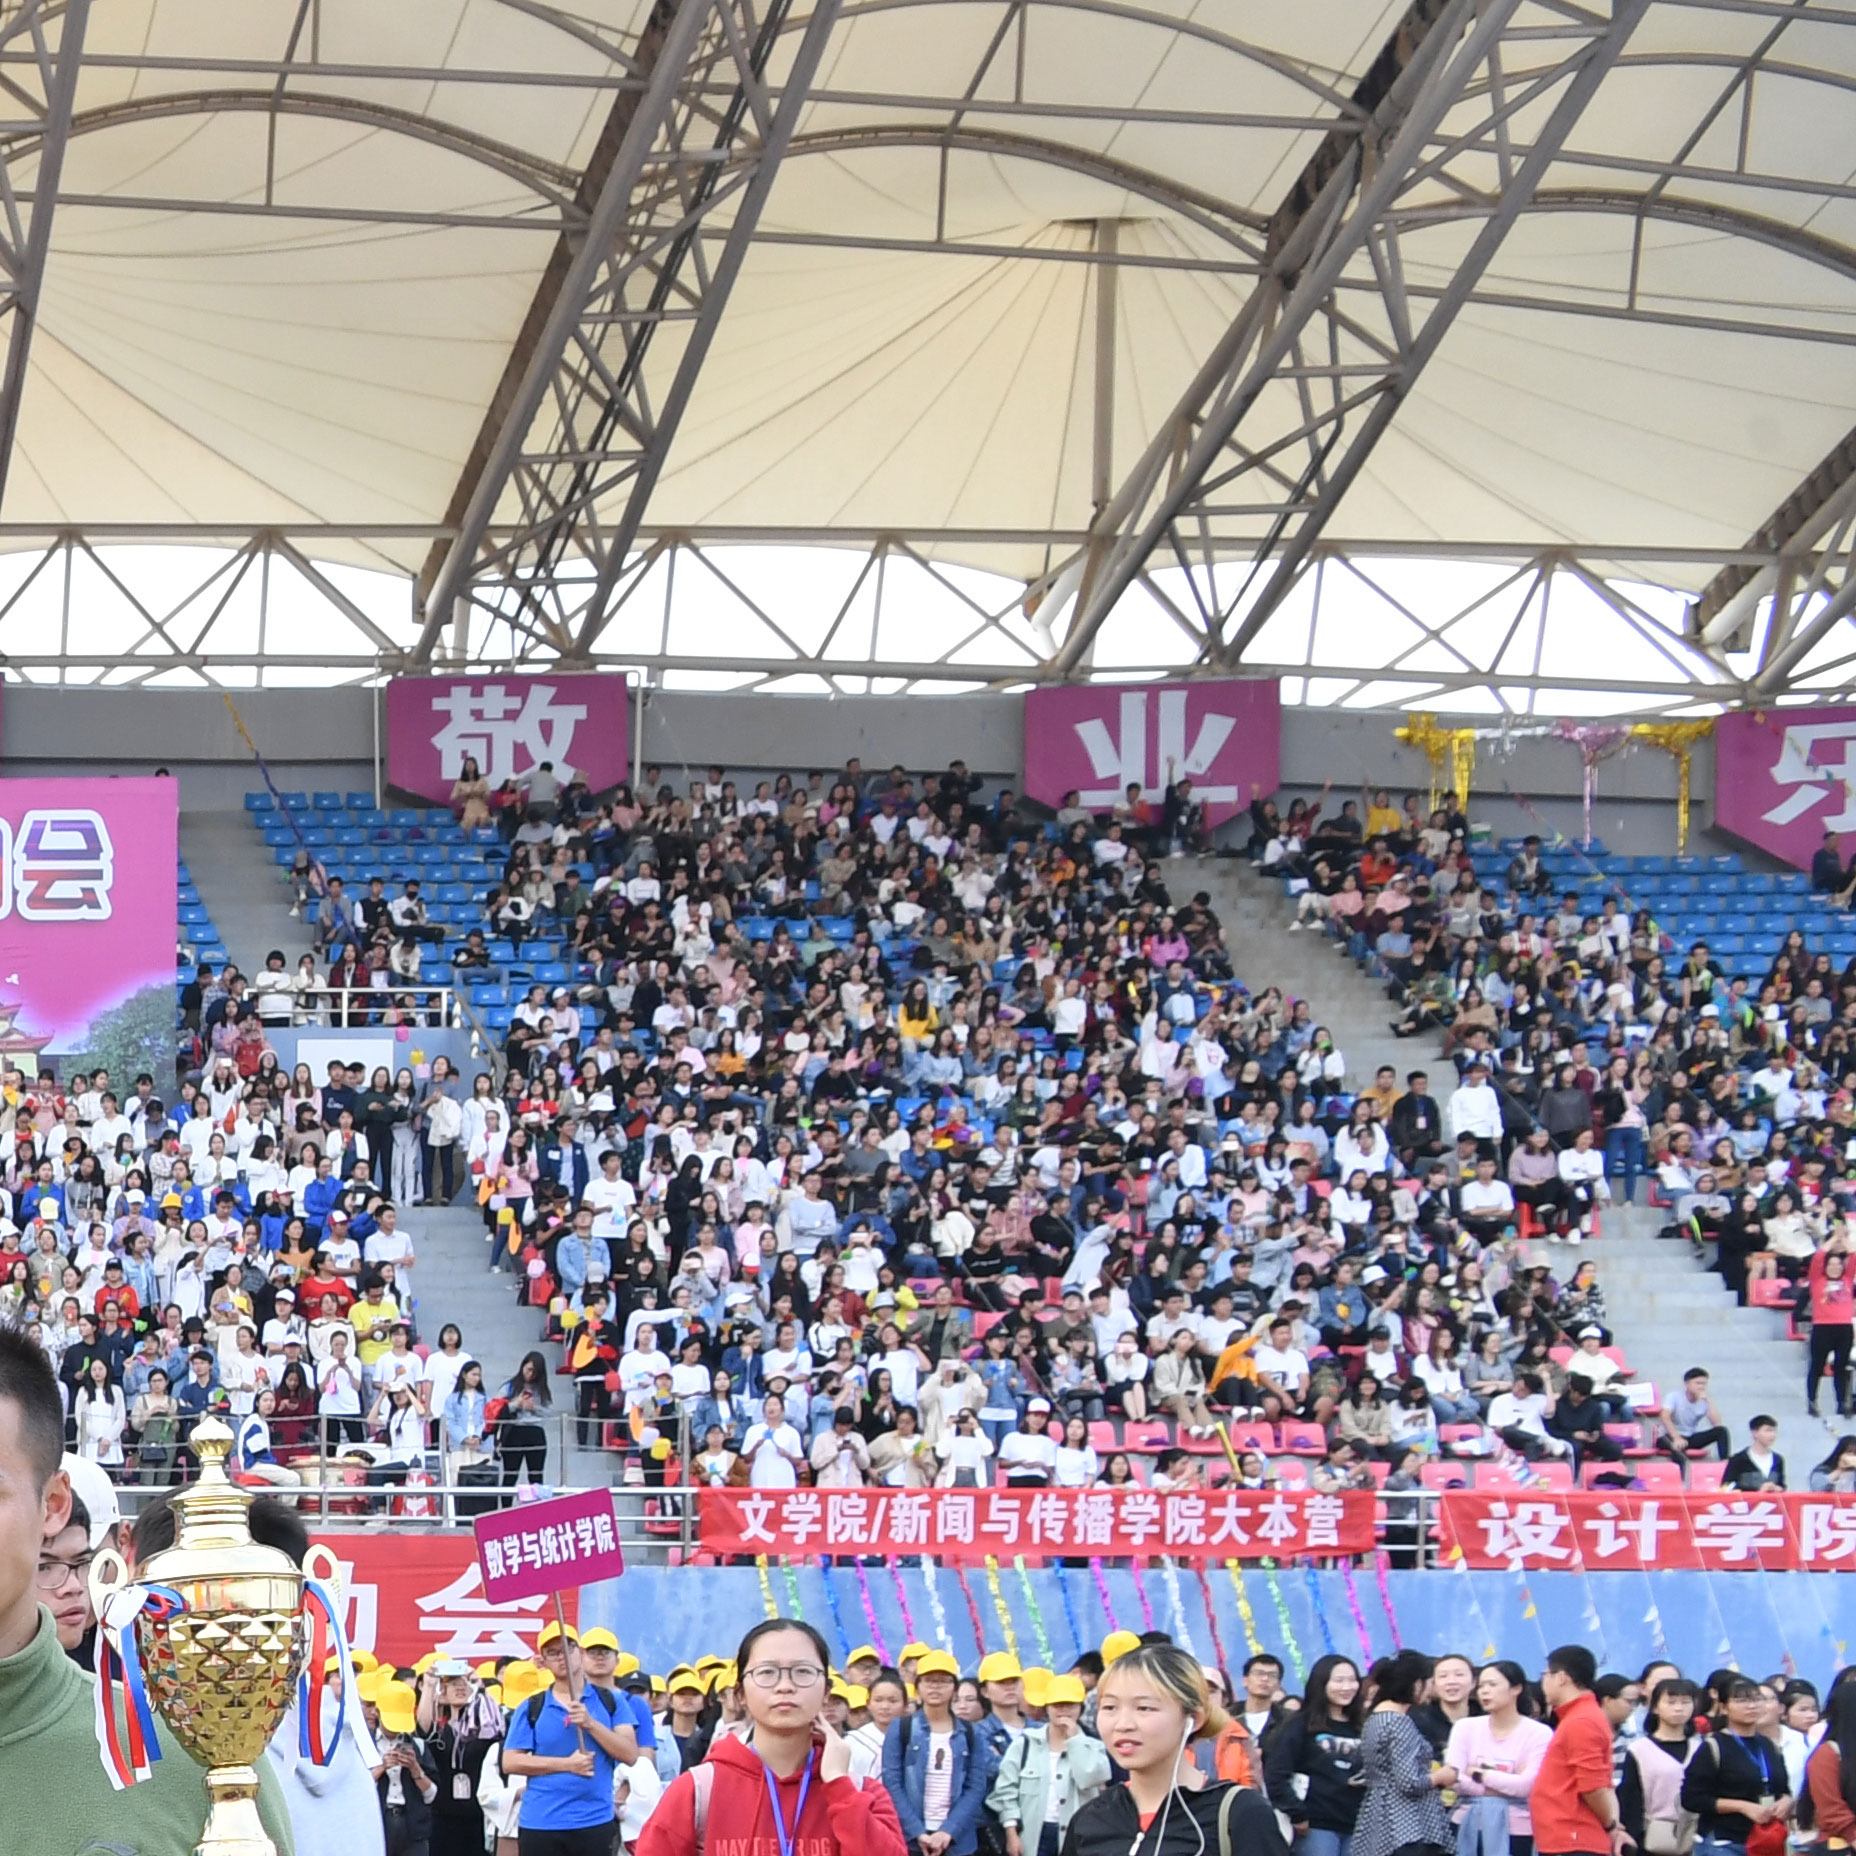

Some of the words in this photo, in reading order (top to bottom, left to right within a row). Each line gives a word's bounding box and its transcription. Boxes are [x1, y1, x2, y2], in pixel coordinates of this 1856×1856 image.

[432, 685, 588, 785] 敬
[1071, 689, 1239, 806] 业
[483, 1512, 617, 1581] 数学与统计学院
[736, 1491, 1345, 1549] 文学院/新闻与传播学院大本营
